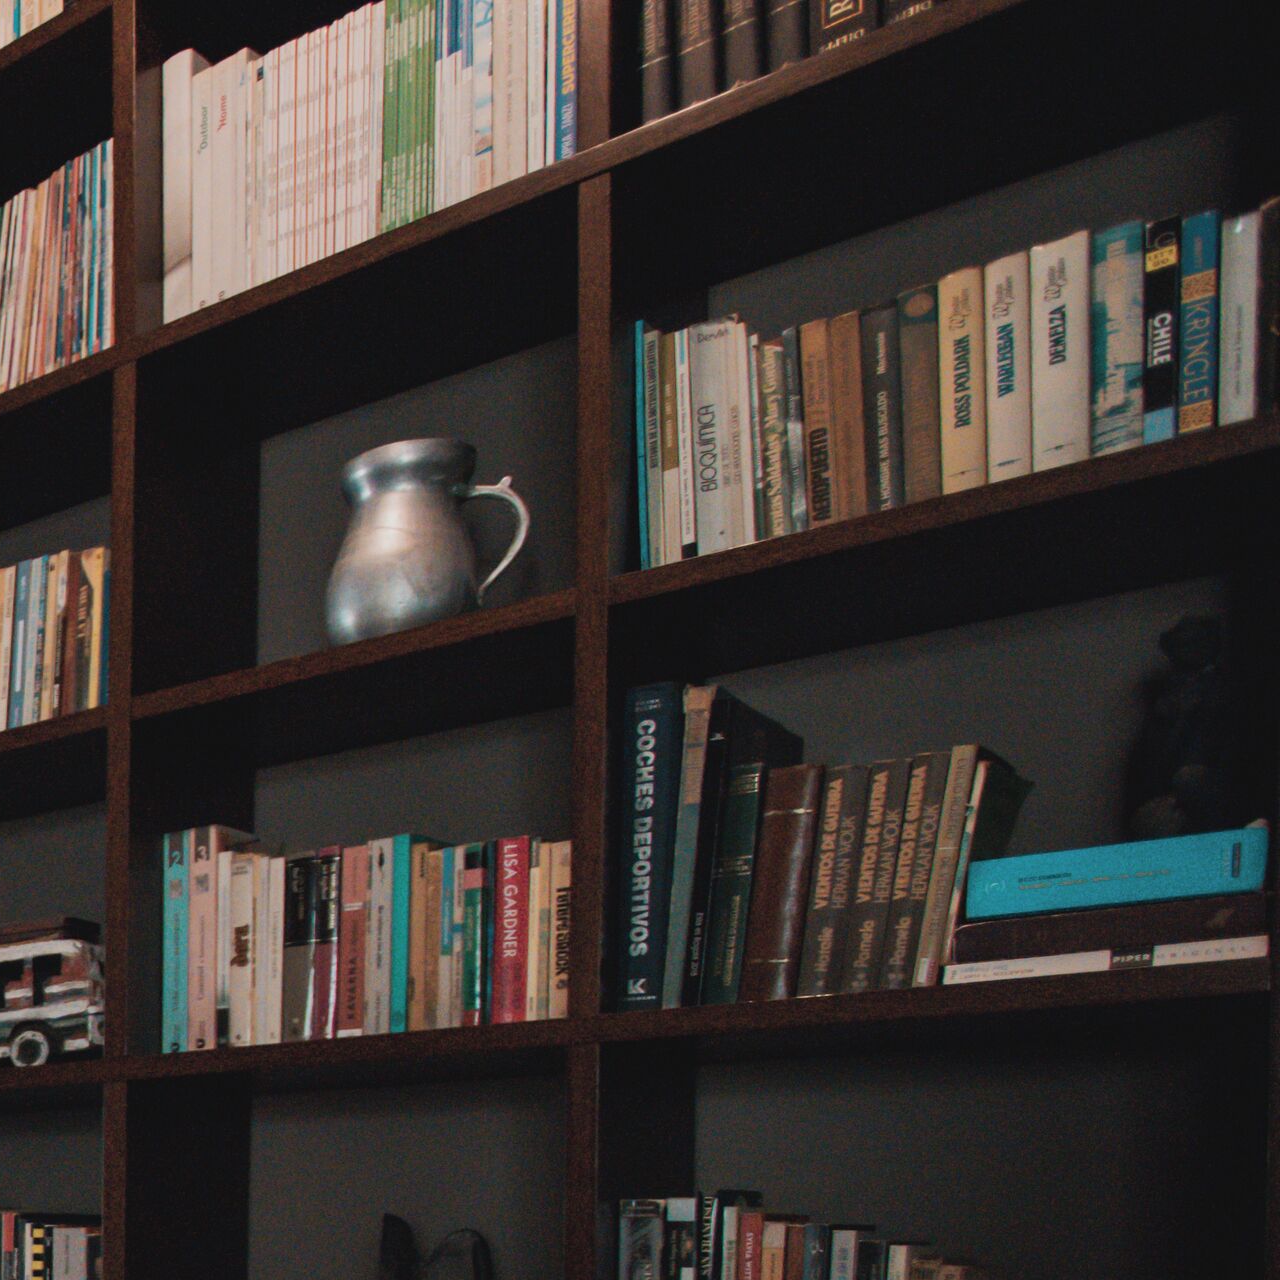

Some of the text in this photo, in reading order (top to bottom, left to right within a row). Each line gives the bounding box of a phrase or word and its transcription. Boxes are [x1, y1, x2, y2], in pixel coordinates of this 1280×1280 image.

[199, 105, 209, 149] Outdoor
[218, 95, 228, 127] Home
[997, 322, 1015, 398] WARLEGGAN
[1048, 305, 1066, 365] DEMELZA
[1152, 312, 1172, 366] CHILE
[1182, 301, 1211, 403] KRINGLE
[877, 391, 889, 435] BUSCADO
[954, 334, 972, 428] ROSS POLDARK
[696, 404, 718, 492] BIOQUÍMICA
[808, 427, 831, 521] AEROPUERTO
[197, 845, 209, 860] 3
[629, 719, 656, 958] COCHES DEPORTIVOS
[814, 778, 843, 910] VIENTOS DE GUERRA
[834, 815, 856, 909] HERMAN WOUK
[856, 770, 889, 904] VIENTOS DE GUERRA
[875, 809, 900, 904] HERMAN WOUK
[893, 766, 928, 900] VIENTOS DE GUERRA
[912, 804, 939, 900] HERMAN WOUK
[503, 844, 518, 958] LISA GARDNER
[1112, 950, 1151, 965] PIPER
[699, 1195, 715, 1276] SAN FRANCISCO
[744, 1232, 754, 1259] SYLVIA
